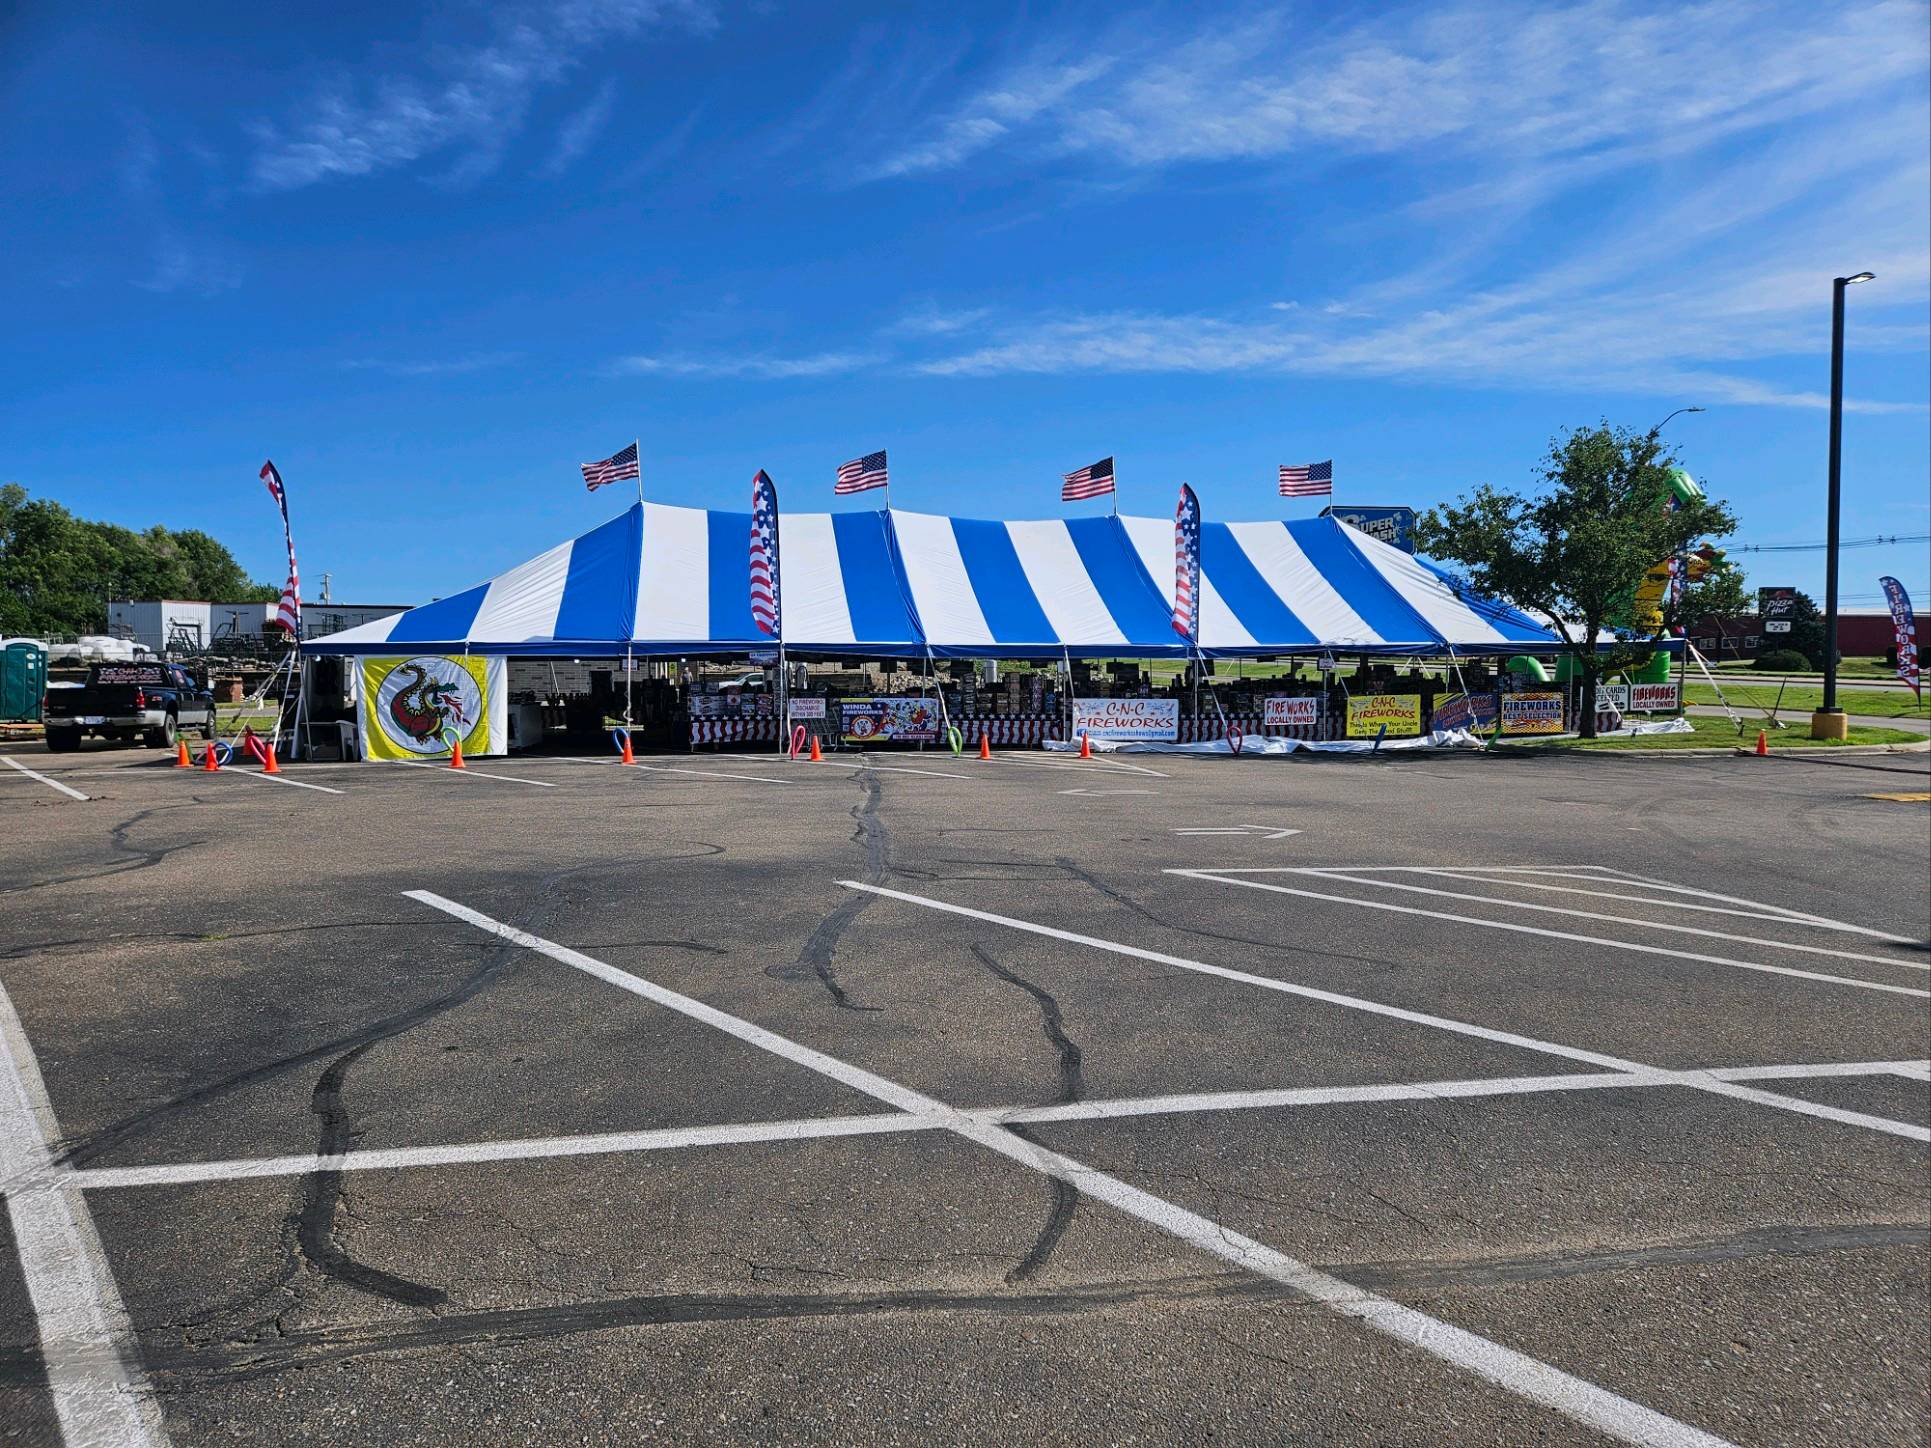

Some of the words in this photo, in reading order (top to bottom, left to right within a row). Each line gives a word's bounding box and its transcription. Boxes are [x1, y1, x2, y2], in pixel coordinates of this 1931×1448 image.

[1605, 686, 1626, 694] CARDS
[1632, 686, 1676, 701] FIREWORKS
[1106, 702, 1145, 716] C-N-C
[1266, 699, 1315, 714] FIREWORKS
[1503, 701, 1561, 711] FIREWORKS
[1633, 701, 1655, 709] LOCALLY
[1655, 700, 1675, 708] OWNED
[1293, 715, 1315, 723] OWNED
[1351, 709, 1415, 721] FIREWORKS
[1077, 717, 1174, 728] FIREWORKS
